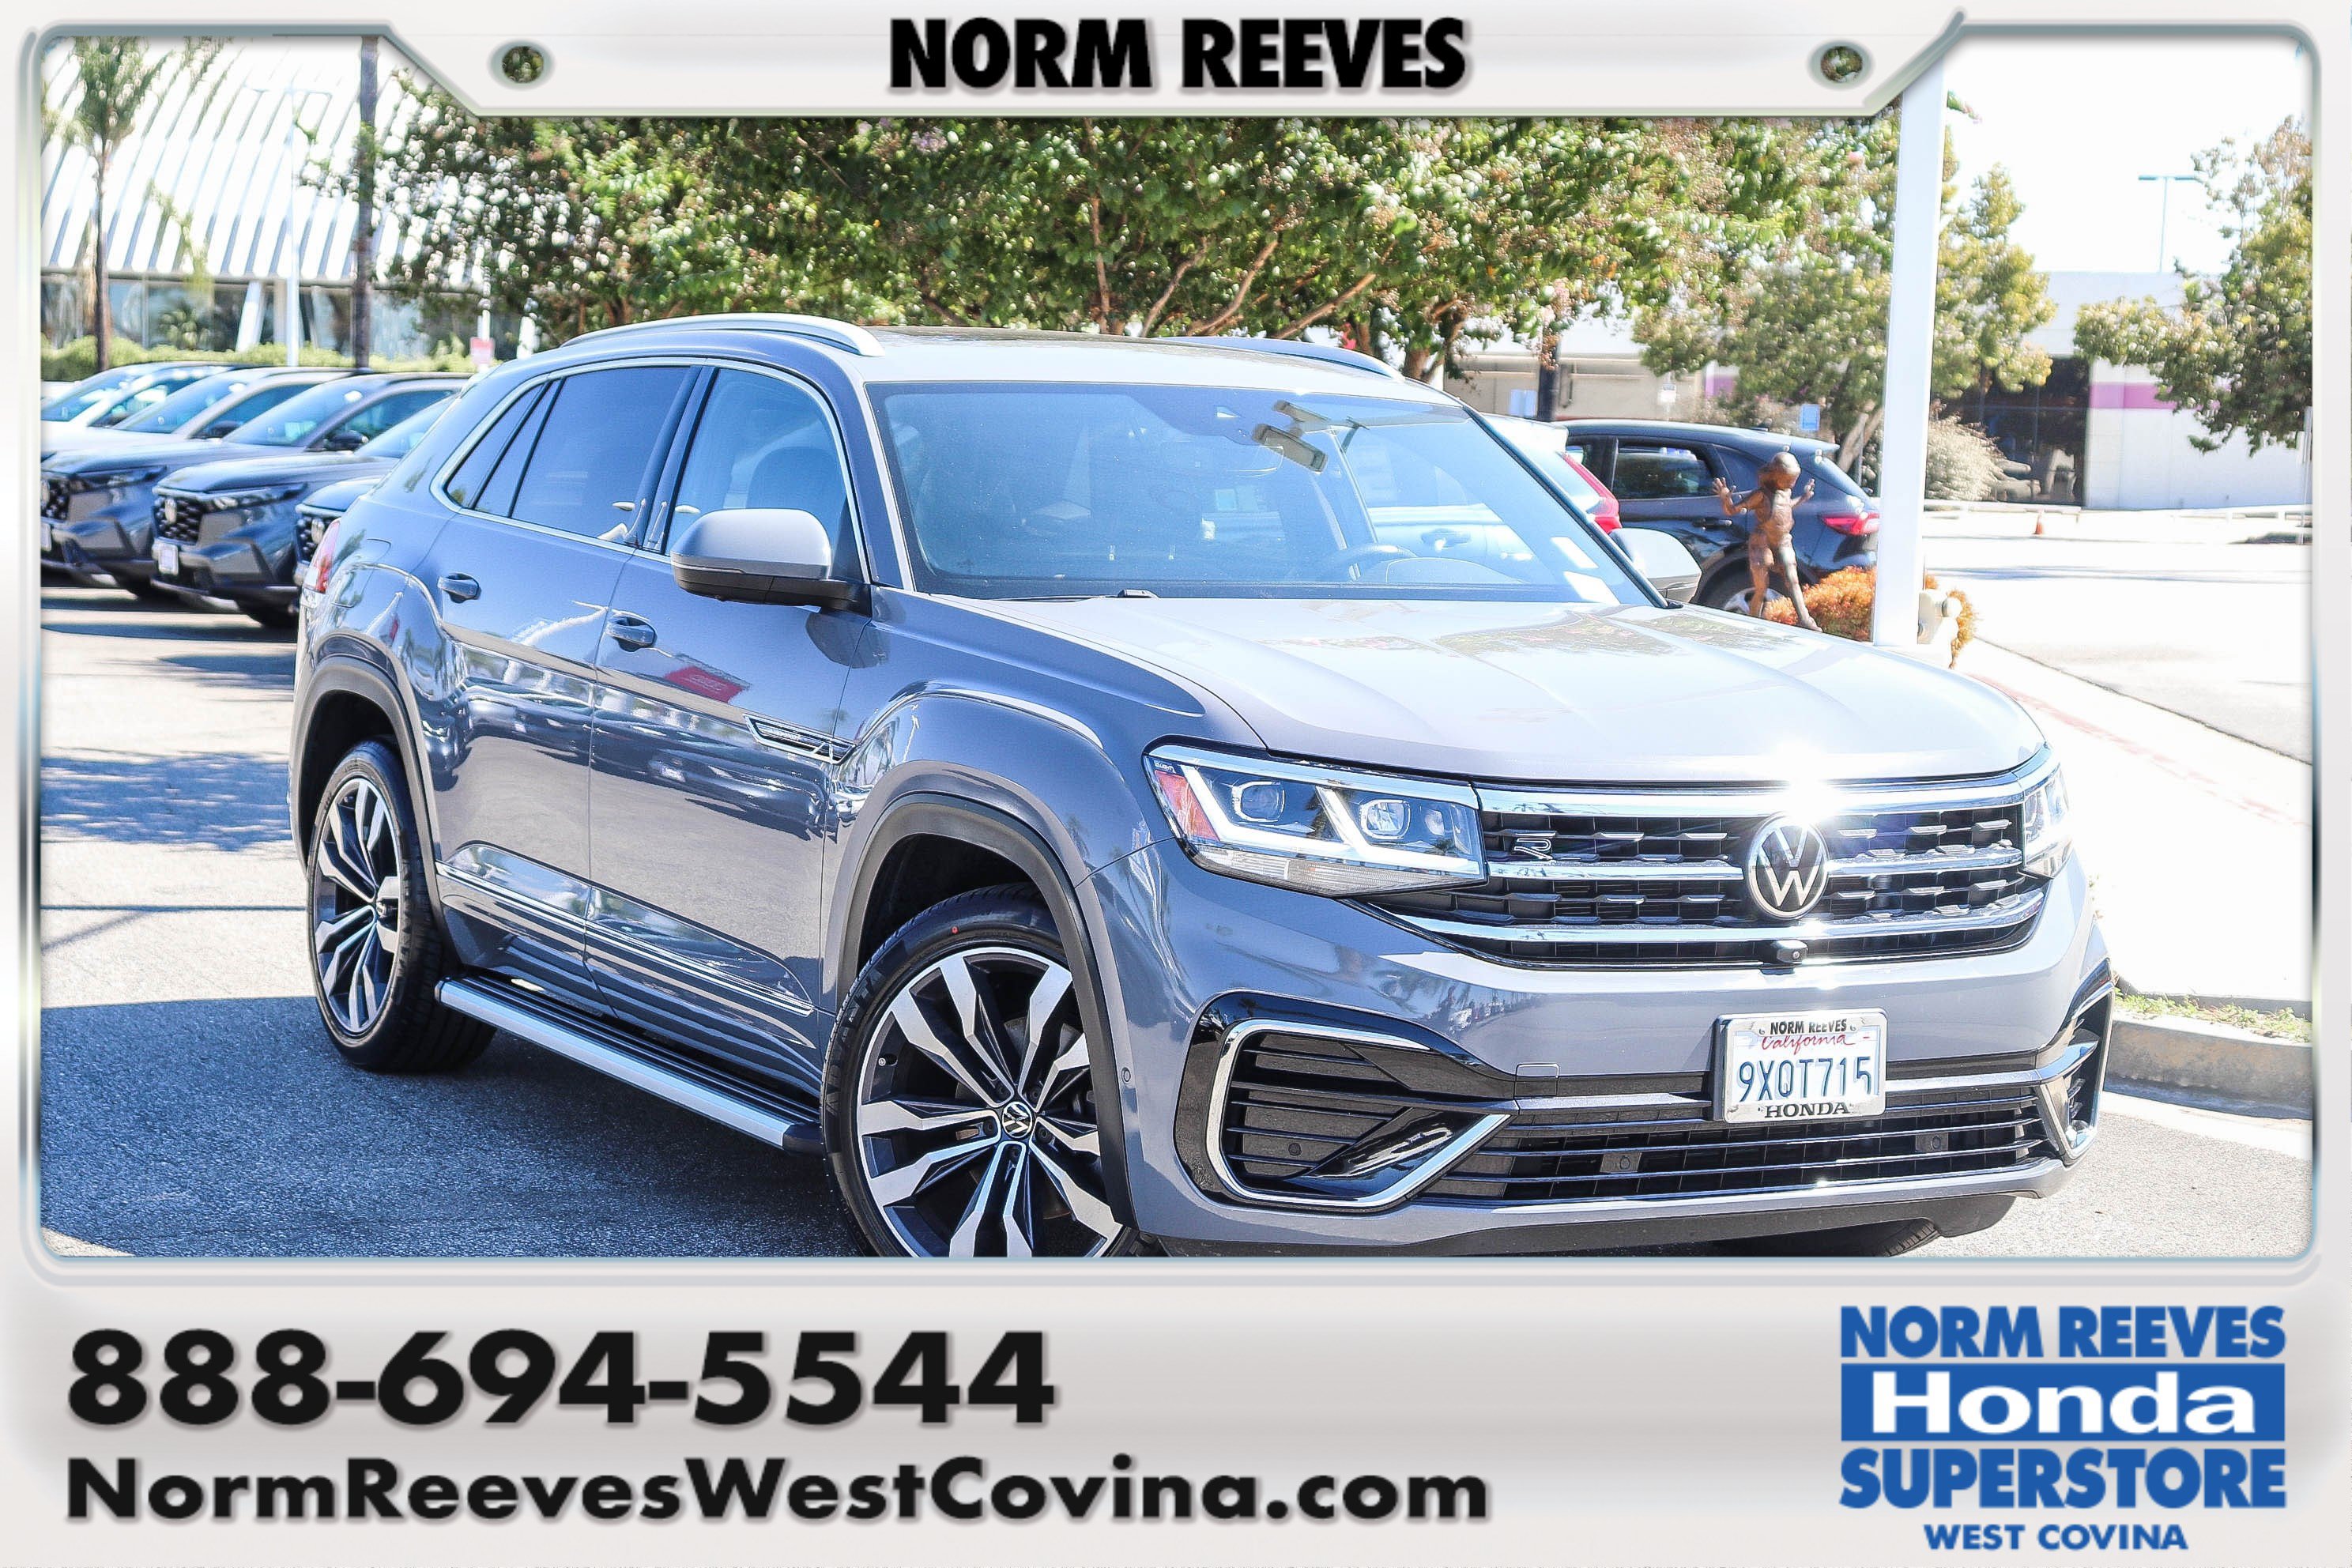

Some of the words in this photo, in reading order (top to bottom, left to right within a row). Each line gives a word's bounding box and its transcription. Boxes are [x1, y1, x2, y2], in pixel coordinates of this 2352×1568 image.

[1770, 1021, 1804, 1035] NORM
[1809, 1019, 1847, 1034] REEVES
[1762, 1034, 1855, 1055] California
[1765, 1102, 1850, 1118] HONDA
